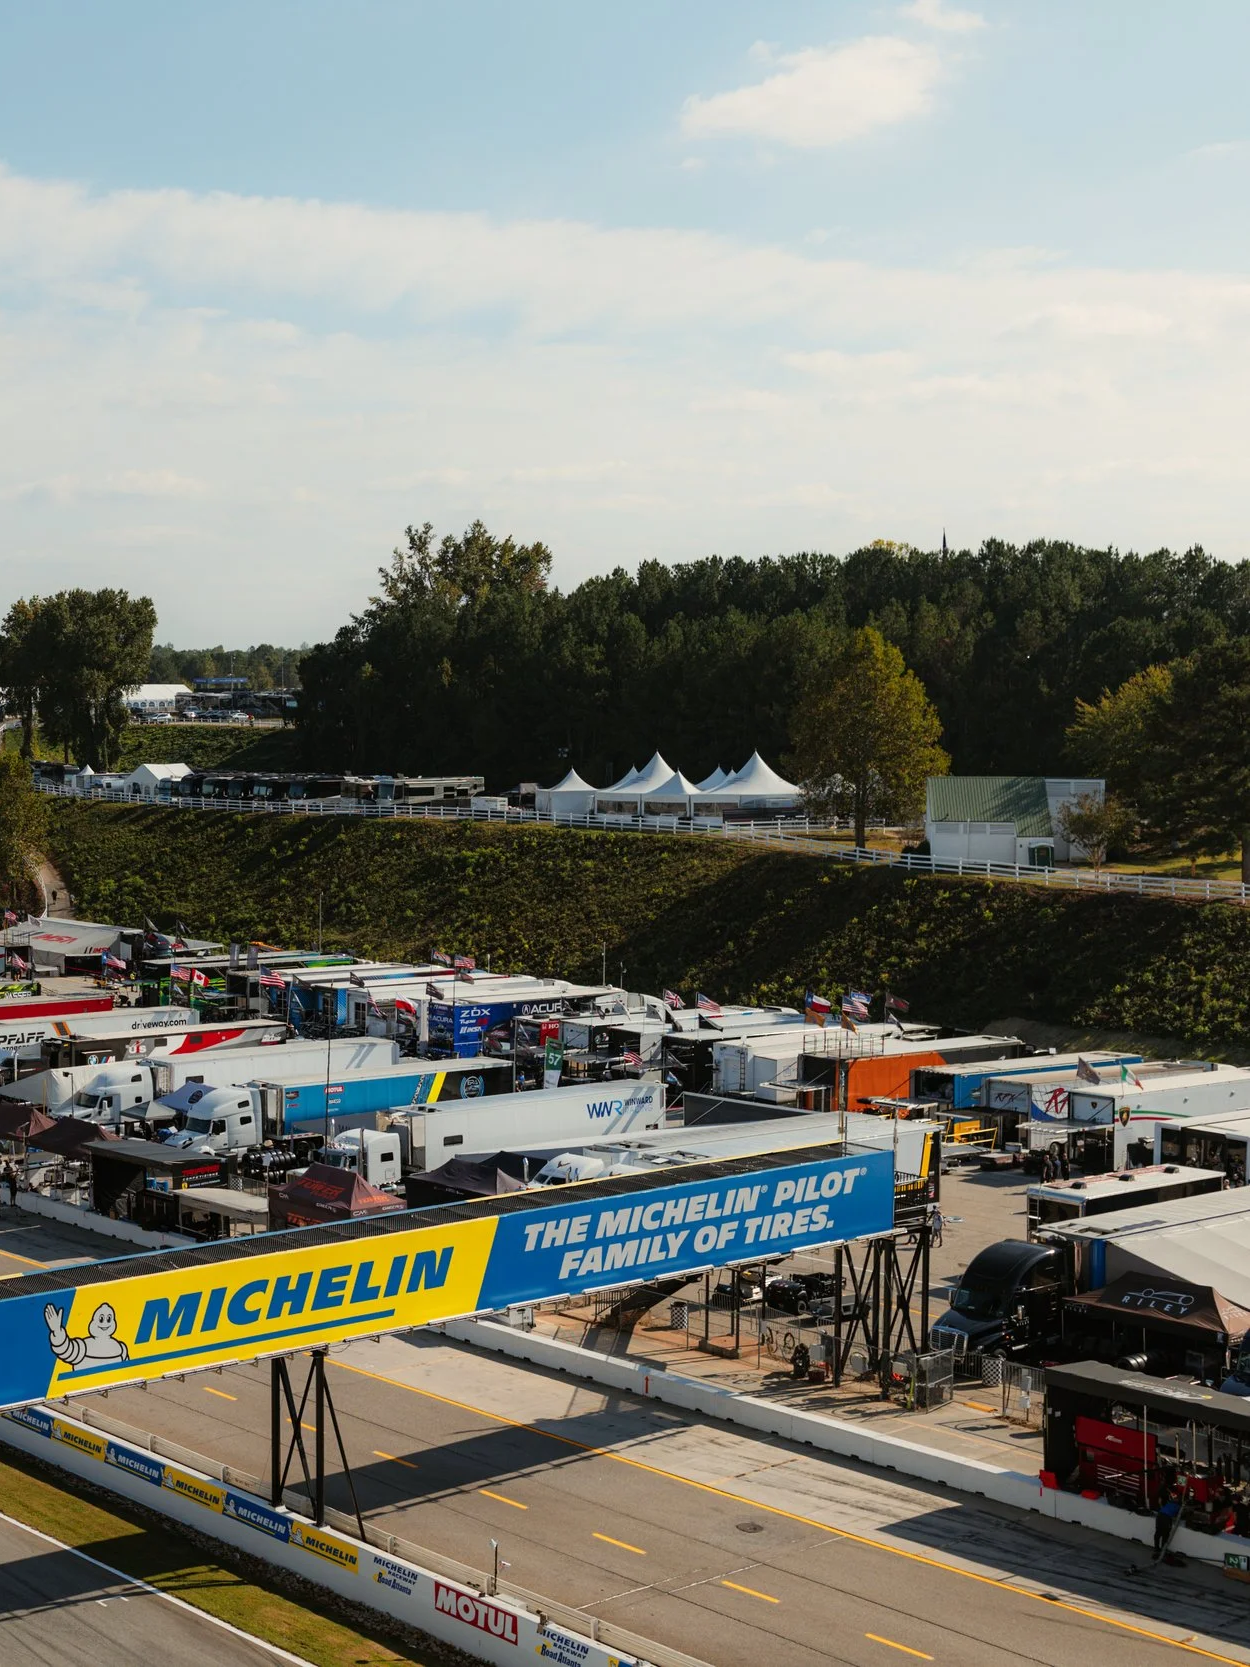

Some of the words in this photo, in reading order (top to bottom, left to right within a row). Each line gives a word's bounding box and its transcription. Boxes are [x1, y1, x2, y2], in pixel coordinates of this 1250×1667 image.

[460, 1008, 491, 1018] ZDX
[548, 1052, 562, 1066] 57
[523, 1215, 590, 1252] THE
[558, 1230, 691, 1280] FAMILY
[693, 1222, 742, 1254] OF
[744, 1205, 834, 1245] TIRES.
[134, 1246, 454, 1345] MICHELIN
[1121, 1295, 1190, 1316] RILEY
[12, 1410, 50, 1431] MICHELIN
[63, 1431, 102, 1454] MICHELIN
[117, 1454, 160, 1479] MICHELIN
[175, 1480, 220, 1505] MICHELIN
[237, 1506, 286, 1535] MICHELIN
[305, 1536, 357, 1566] MICHELIN
[373, 1556, 419, 1581] MICHELIN
[387, 1570, 417, 1586] RACEWAY
[377, 1571, 393, 1589] Road
[391, 1577, 412, 1596] Atlanta
[436, 1583, 518, 1644] MOTUL
[540, 1628, 590, 1655] MICHELIN
[553, 1642, 587, 1660] RACEWAY
[541, 1644, 558, 1660] Road
[557, 1652, 582, 1667] Atlanta
